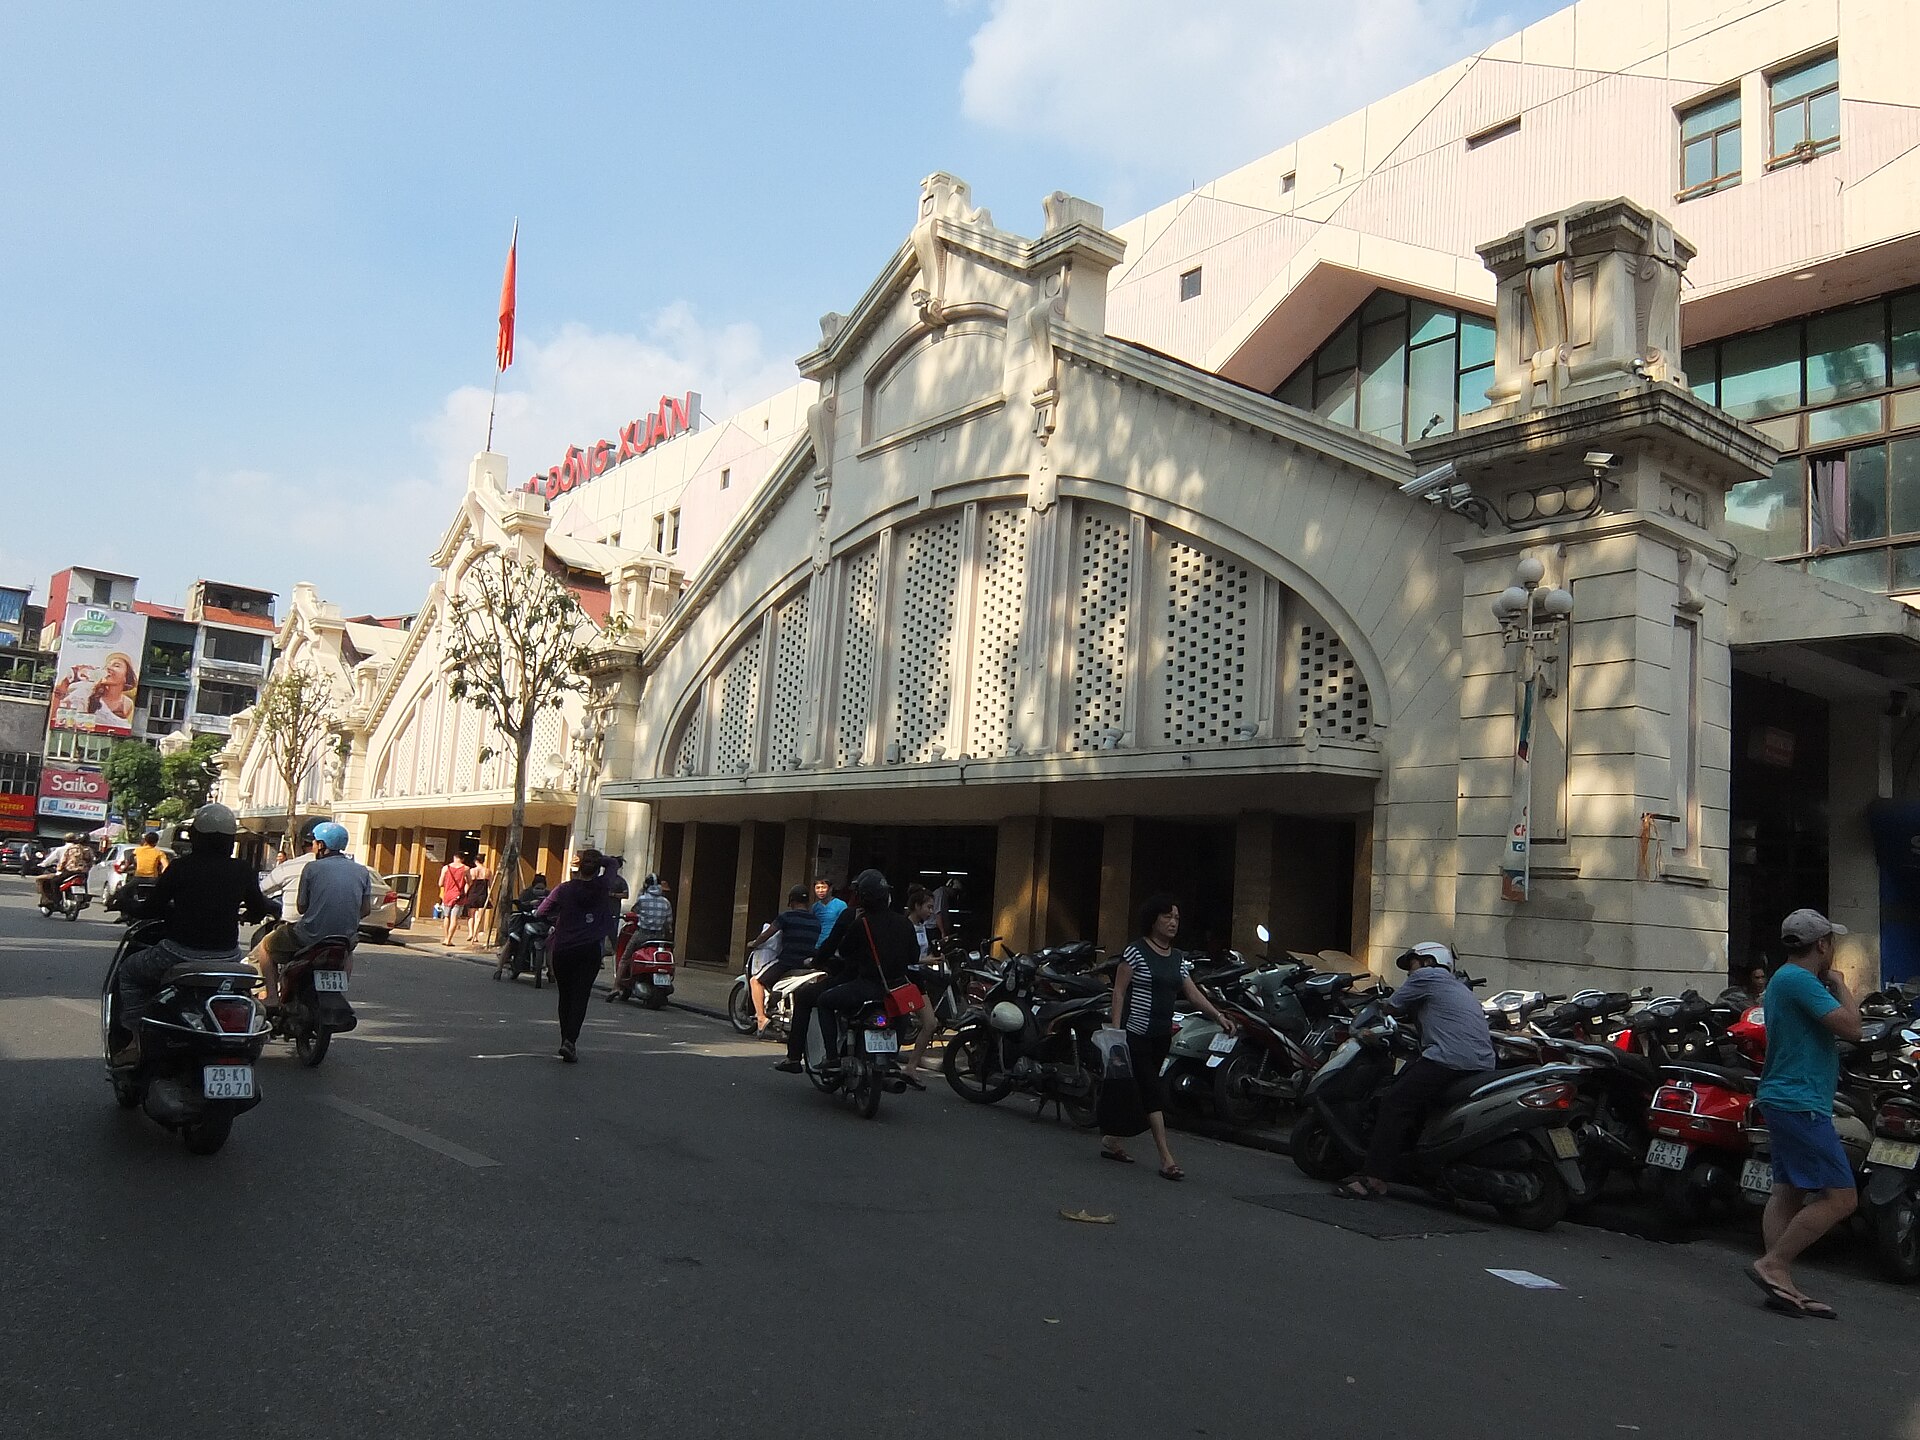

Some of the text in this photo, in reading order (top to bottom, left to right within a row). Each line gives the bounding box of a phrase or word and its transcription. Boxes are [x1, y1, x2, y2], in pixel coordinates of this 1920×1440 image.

[51, 774, 99, 793] Saiko
[212, 1068, 246, 1082] 29-K1
[208, 1083, 252, 1097] 428.70
[1654, 1141, 1682, 1156] 29-F1
